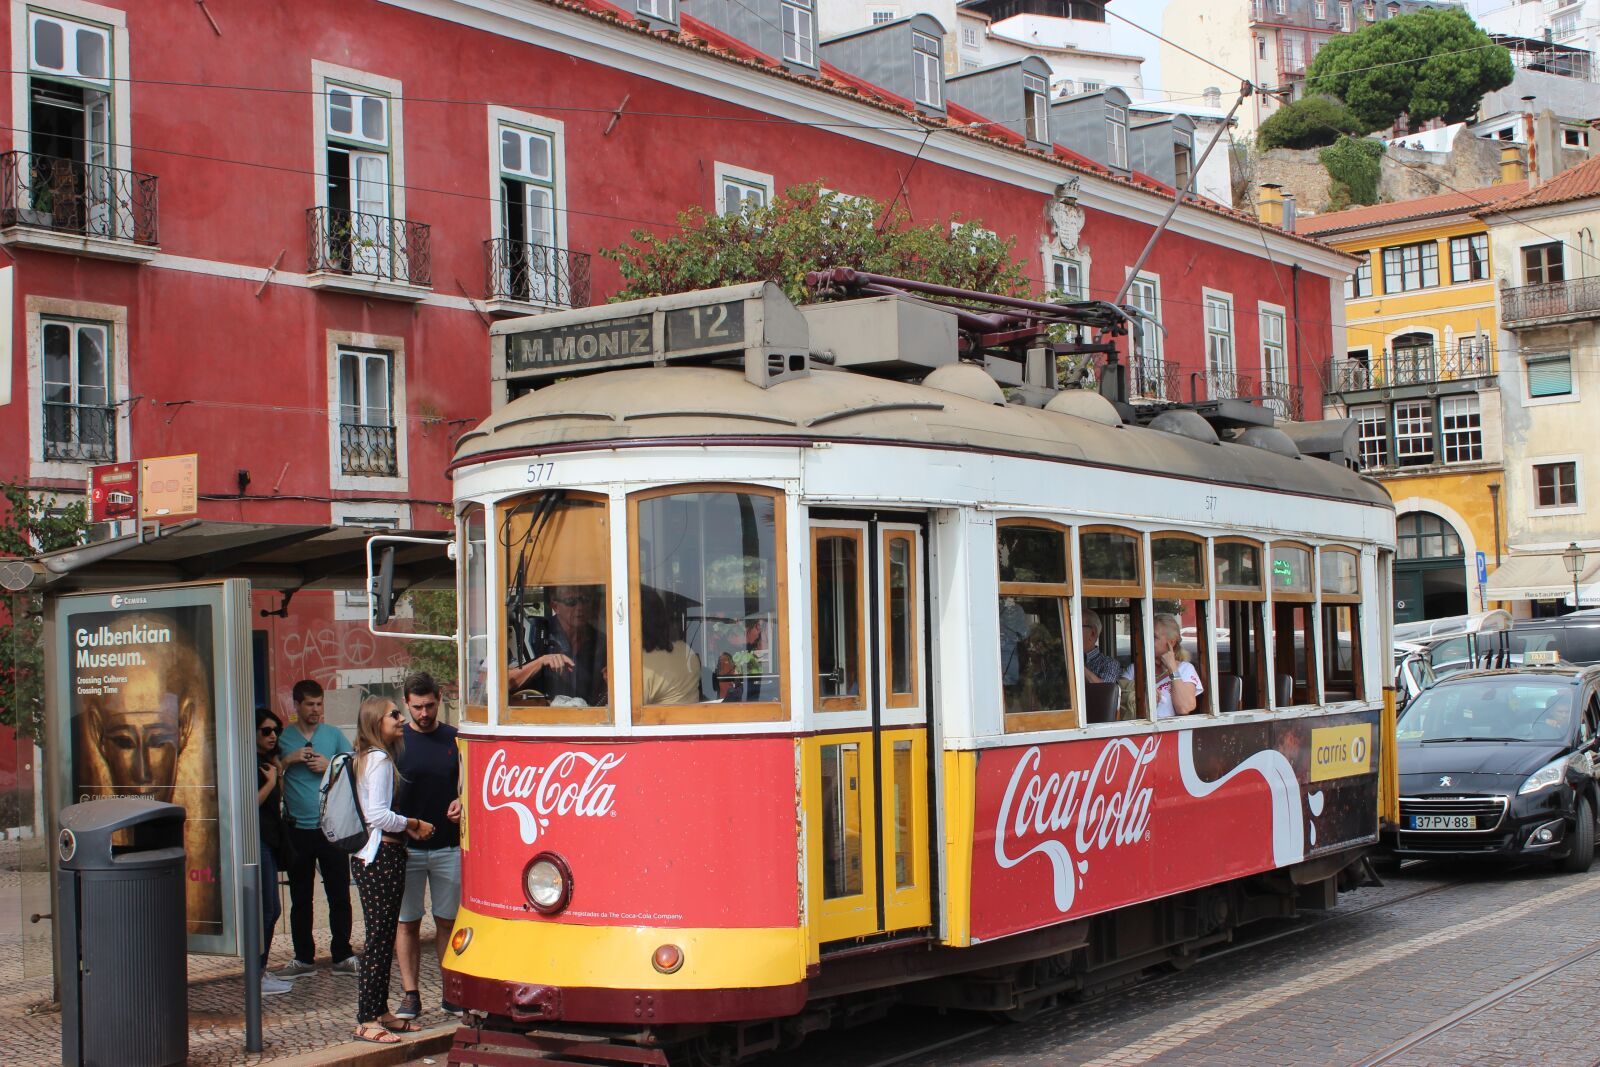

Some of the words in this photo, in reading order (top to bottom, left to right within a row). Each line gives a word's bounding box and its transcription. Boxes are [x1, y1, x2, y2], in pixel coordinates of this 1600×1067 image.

[520, 328, 650, 363] M.MONIZ
[688, 304, 729, 340] 12
[527, 462, 554, 482] 577
[95, 490, 100, 498] 2
[1205, 495, 1217, 510] 577
[1478, 554, 1484, 580] P
[76, 624, 170, 648] Gulbenkian
[76, 650, 146, 668] Museum.
[77, 676, 102, 685] Crossing
[104, 675, 128, 684] Cultures
[77, 686, 102, 695] Crossing
[104, 685, 118, 694] Time
[1317, 736, 1347, 765] carris
[482, 749, 627, 844] Coca-Cola
[995, 735, 1162, 912] Coca-Cola
[190, 866, 216, 882] art.
